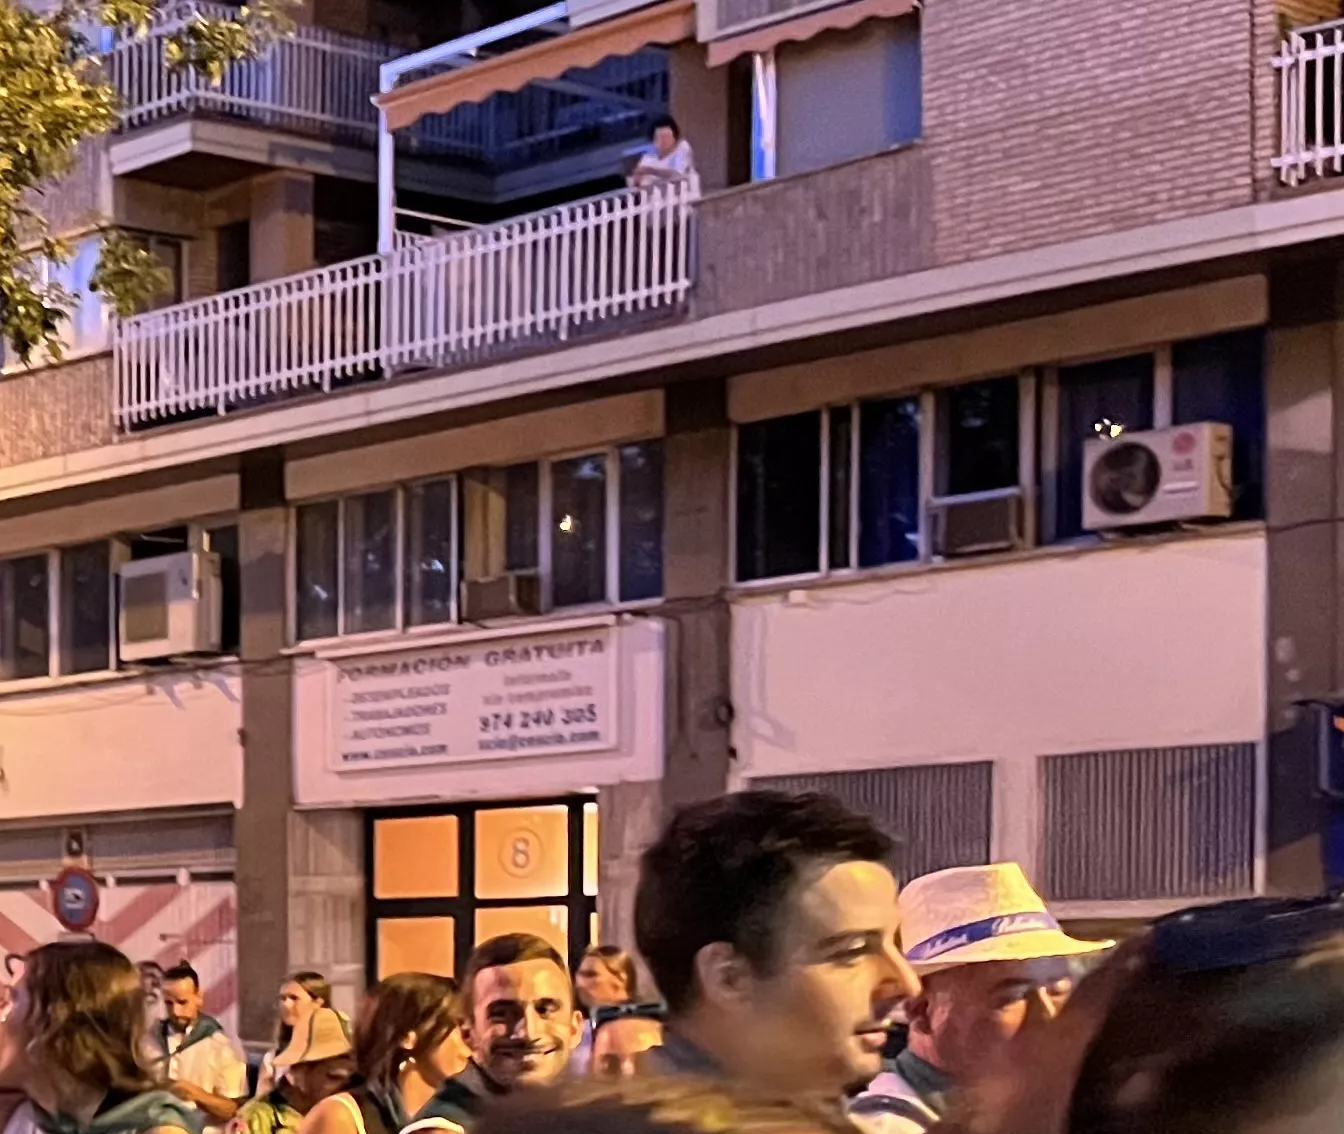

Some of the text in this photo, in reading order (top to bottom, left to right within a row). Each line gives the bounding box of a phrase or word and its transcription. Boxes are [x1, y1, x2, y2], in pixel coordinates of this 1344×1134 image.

[483, 640, 605, 668] GRATUITA
[478, 712, 512, 732] 974
[520, 708, 554, 728] 240
[511, 836, 531, 869] 8
